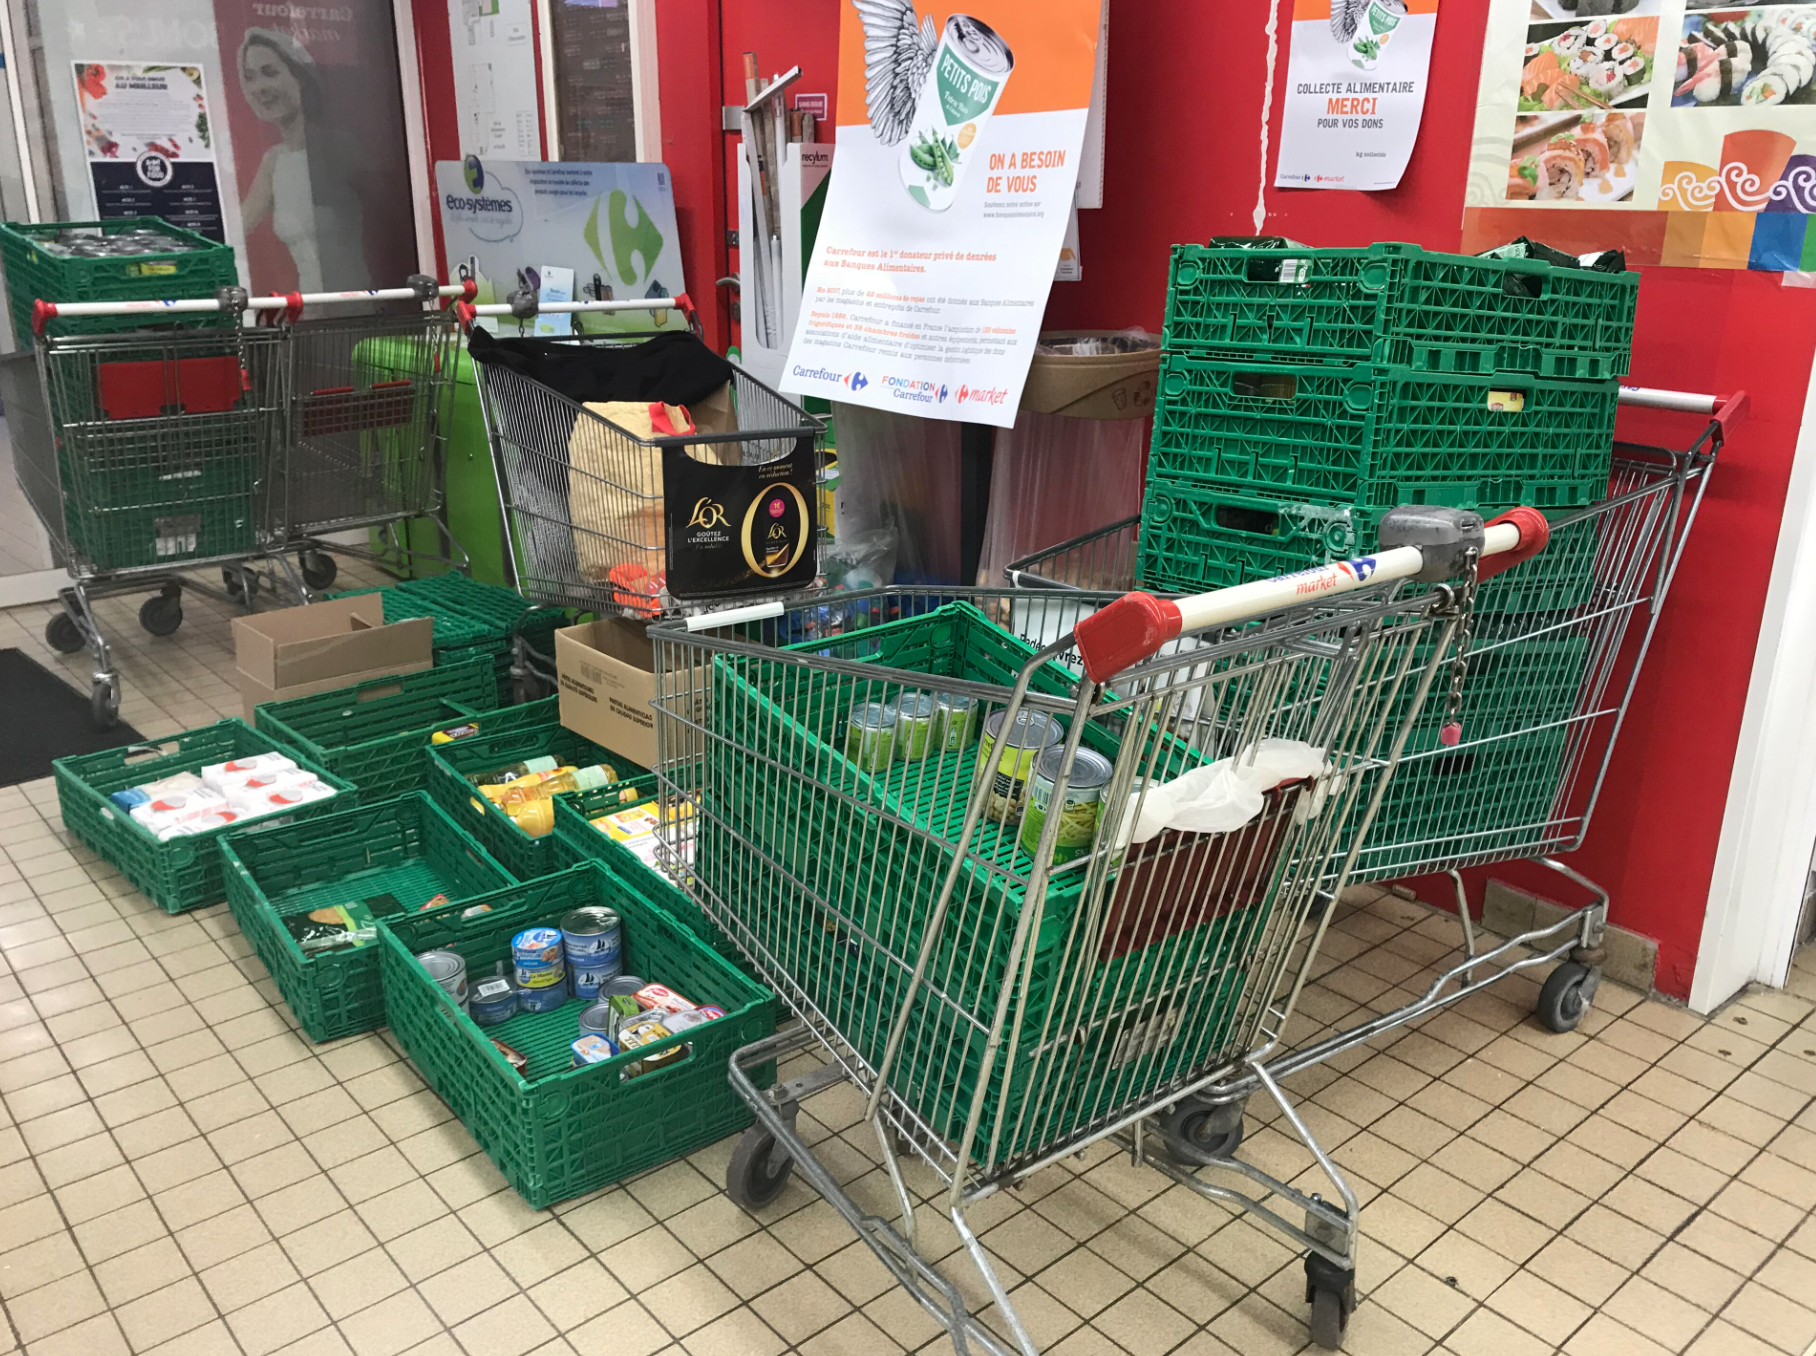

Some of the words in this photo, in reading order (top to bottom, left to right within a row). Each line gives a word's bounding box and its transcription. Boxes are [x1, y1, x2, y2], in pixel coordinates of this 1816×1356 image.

[940, 53, 971, 94] PETITS
[968, 79, 991, 104] POIS
[1297, 83, 1343, 94] COLLECTE
[1345, 81, 1414, 94] ALIMENTAIRE
[1327, 97, 1378, 115] MERCI
[1317, 118, 1339, 129] POUR
[1342, 118, 1359, 129] VOS
[1361, 118, 1384, 129] DONS
[801, 150, 828, 164] recylum
[989, 153, 1005, 170] ON
[1008, 152, 1017, 170] A
[1020, 150, 1066, 169] BESOIN
[986, 176, 1002, 193] DE
[1006, 175, 1037, 193] VOUS
[826, 246, 867, 257] Carrefour
[867, 250, 879, 258] est
[880, 249, 887, 258] le
[899, 250, 932, 260] donateur
[933, 250, 953, 261] privé
[954, 251, 964, 260] de
[965, 251, 997, 261] denrées
[823, 259, 839, 267] aux
[840, 259, 875, 271] Banques
[876, 262, 927, 273] Alimentaires.
[835, 297, 864, 306] magasins
[841, 288, 855, 296] plus
[856, 289, 864, 297] de
[875, 292, 902, 301] millions
[849, 314, 883, 325] Carrefour
[864, 326, 898, 337] chambres
[843, 341, 877, 353] Carrefour
[862, 335, 903, 348] alimentaire
[792, 364, 842, 383] Carrefour
[882, 375, 936, 392] FONDATION
[893, 388, 933, 403] Carrefour
[968, 387, 1008, 405] market
[1296, 573, 1337, 595] market
